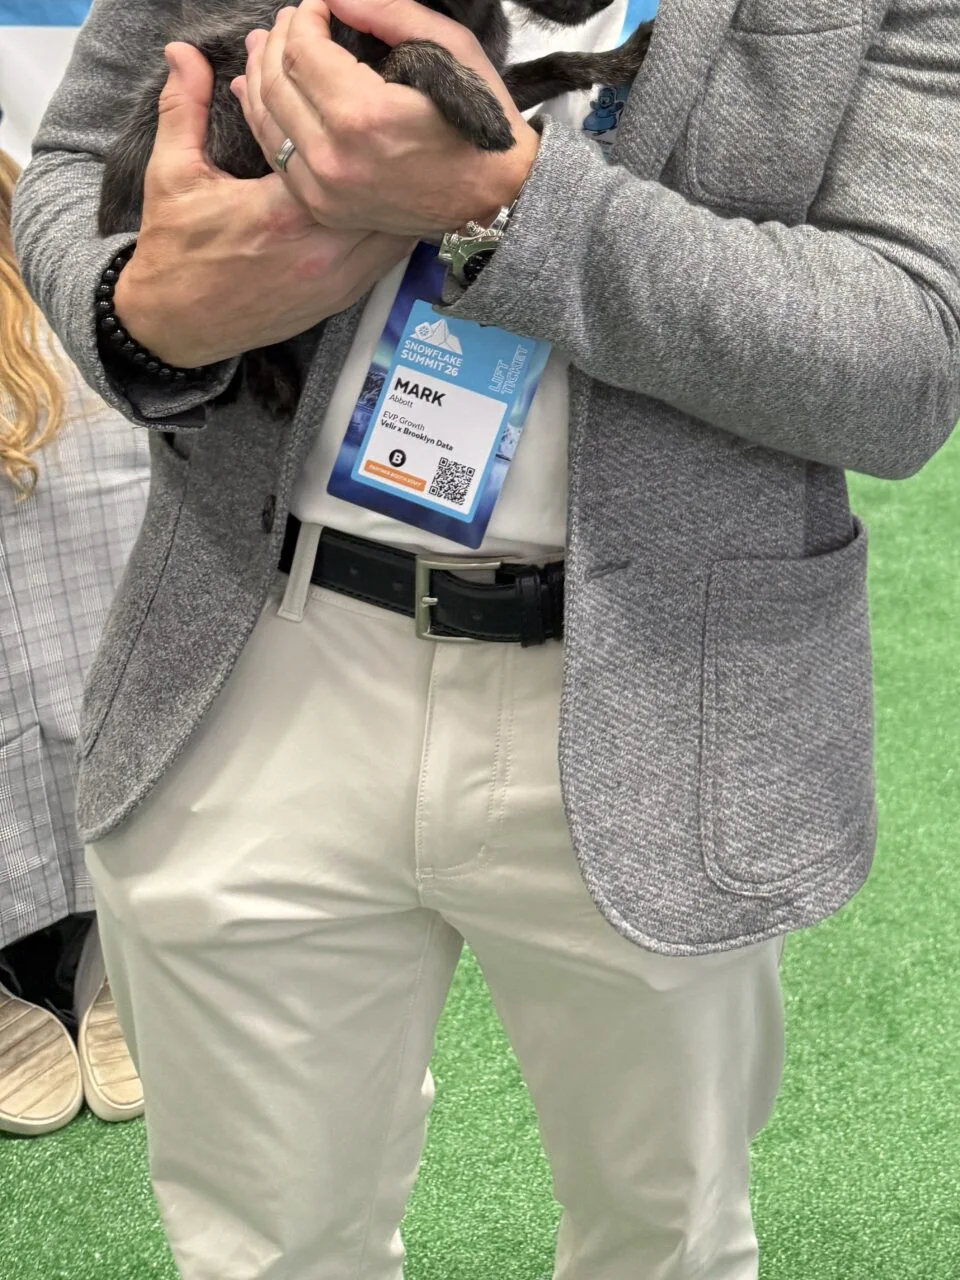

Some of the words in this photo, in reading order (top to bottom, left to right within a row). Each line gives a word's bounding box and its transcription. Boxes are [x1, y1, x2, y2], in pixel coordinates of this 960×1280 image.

[400, 349, 445, 371] SUMMIT
[403, 340, 463, 368] SNOWFLAKE
[389, 394, 413, 408] Abbott
[394, 377, 446, 407] MARK
[380, 419, 397, 431] Velir
[403, 427, 435, 445] Brooklyn
[436, 439, 453, 451] Data
[399, 417, 425, 431] Growth
